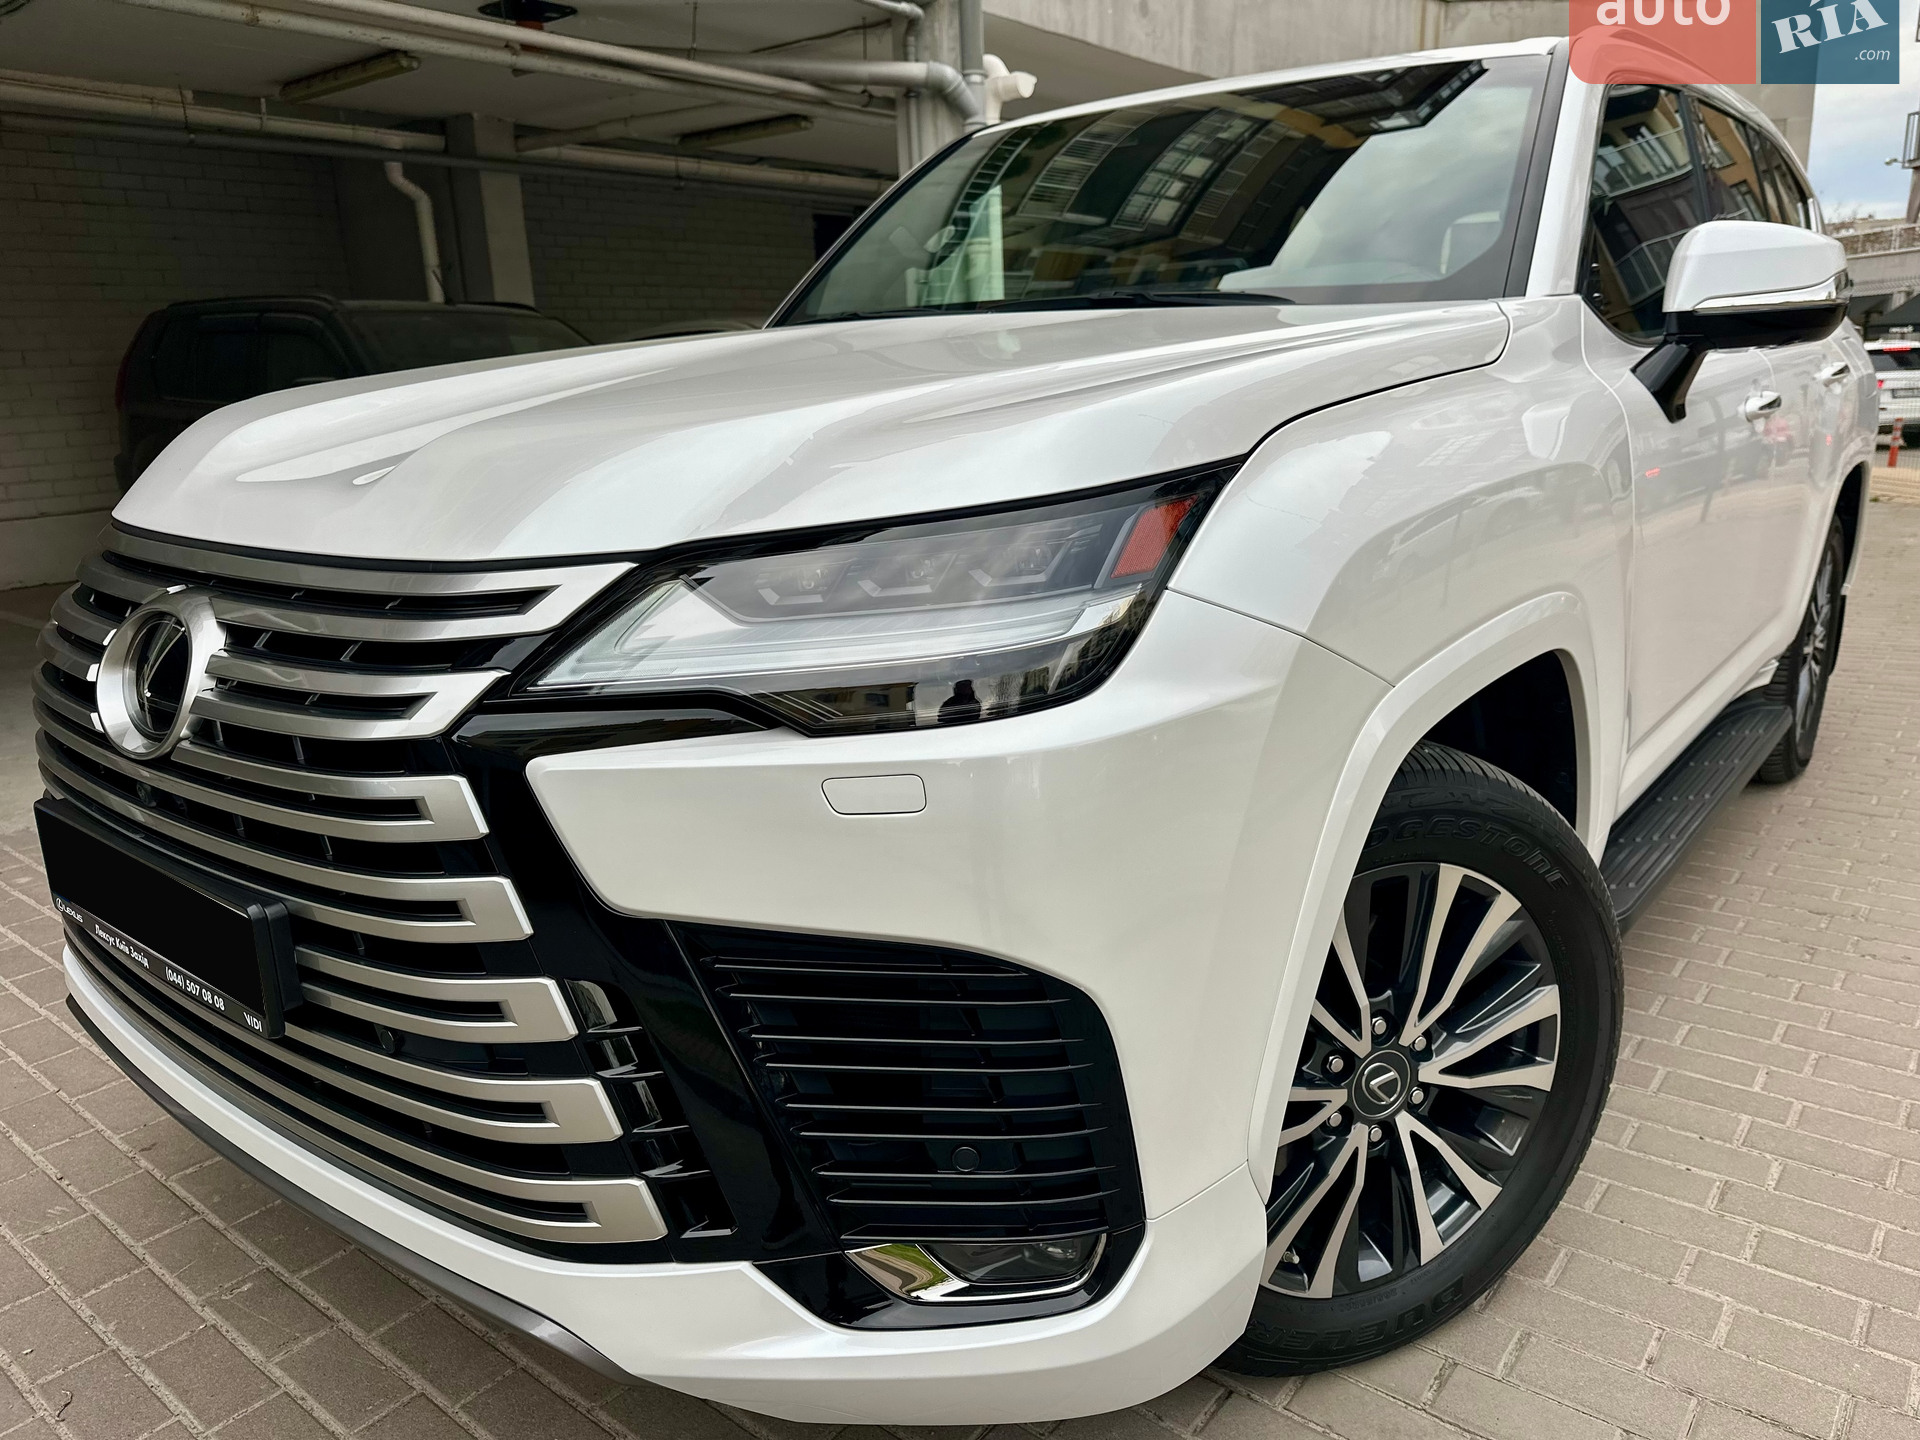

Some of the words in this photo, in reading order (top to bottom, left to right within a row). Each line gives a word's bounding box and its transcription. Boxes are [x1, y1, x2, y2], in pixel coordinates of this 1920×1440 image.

[1362, 815, 1571, 892] DGESTONE
[63, 904, 84, 923] LEXUS
[94, 924, 116, 947] Лексус
[115, 936, 130, 955] Київ
[130, 946, 150, 969] Захід
[165, 966, 185, 990] (044)
[186, 979, 200, 997] 507
[202, 988, 213, 1005] 08
[213, 995, 225, 1011] 08
[243, 1011, 263, 1033] VIDI
